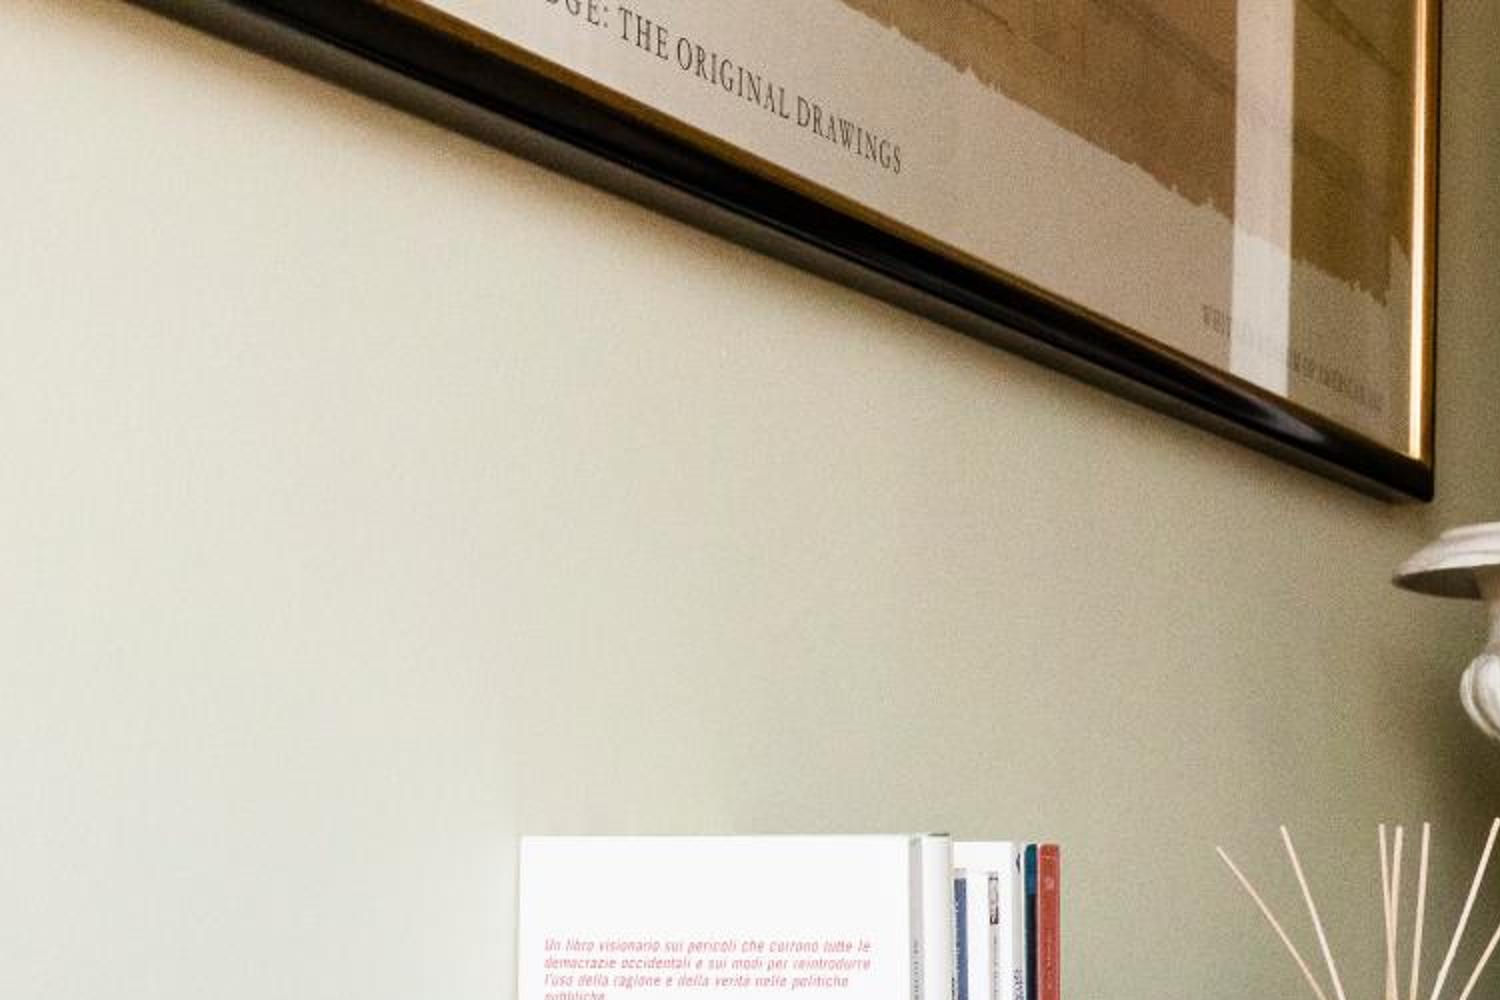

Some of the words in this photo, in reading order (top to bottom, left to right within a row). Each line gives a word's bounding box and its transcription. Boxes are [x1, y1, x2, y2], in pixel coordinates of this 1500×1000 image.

[618, 7, 669, 60] THE
[677, 37, 790, 119] ORIGINAL
[797, 95, 901, 175] DRAWINGS
[599, 938, 661, 951] visionario
[687, 939, 736, 954] pericoli
[741, 940, 764, 953] che
[544, 956, 617, 969] democrazie
[620, 956, 691, 970] occidentali
[577, 973, 609, 987] della
[677, 974, 709, 987] della
[755, 974, 787, 988] nelle
[791, 974, 849, 990] politiche
